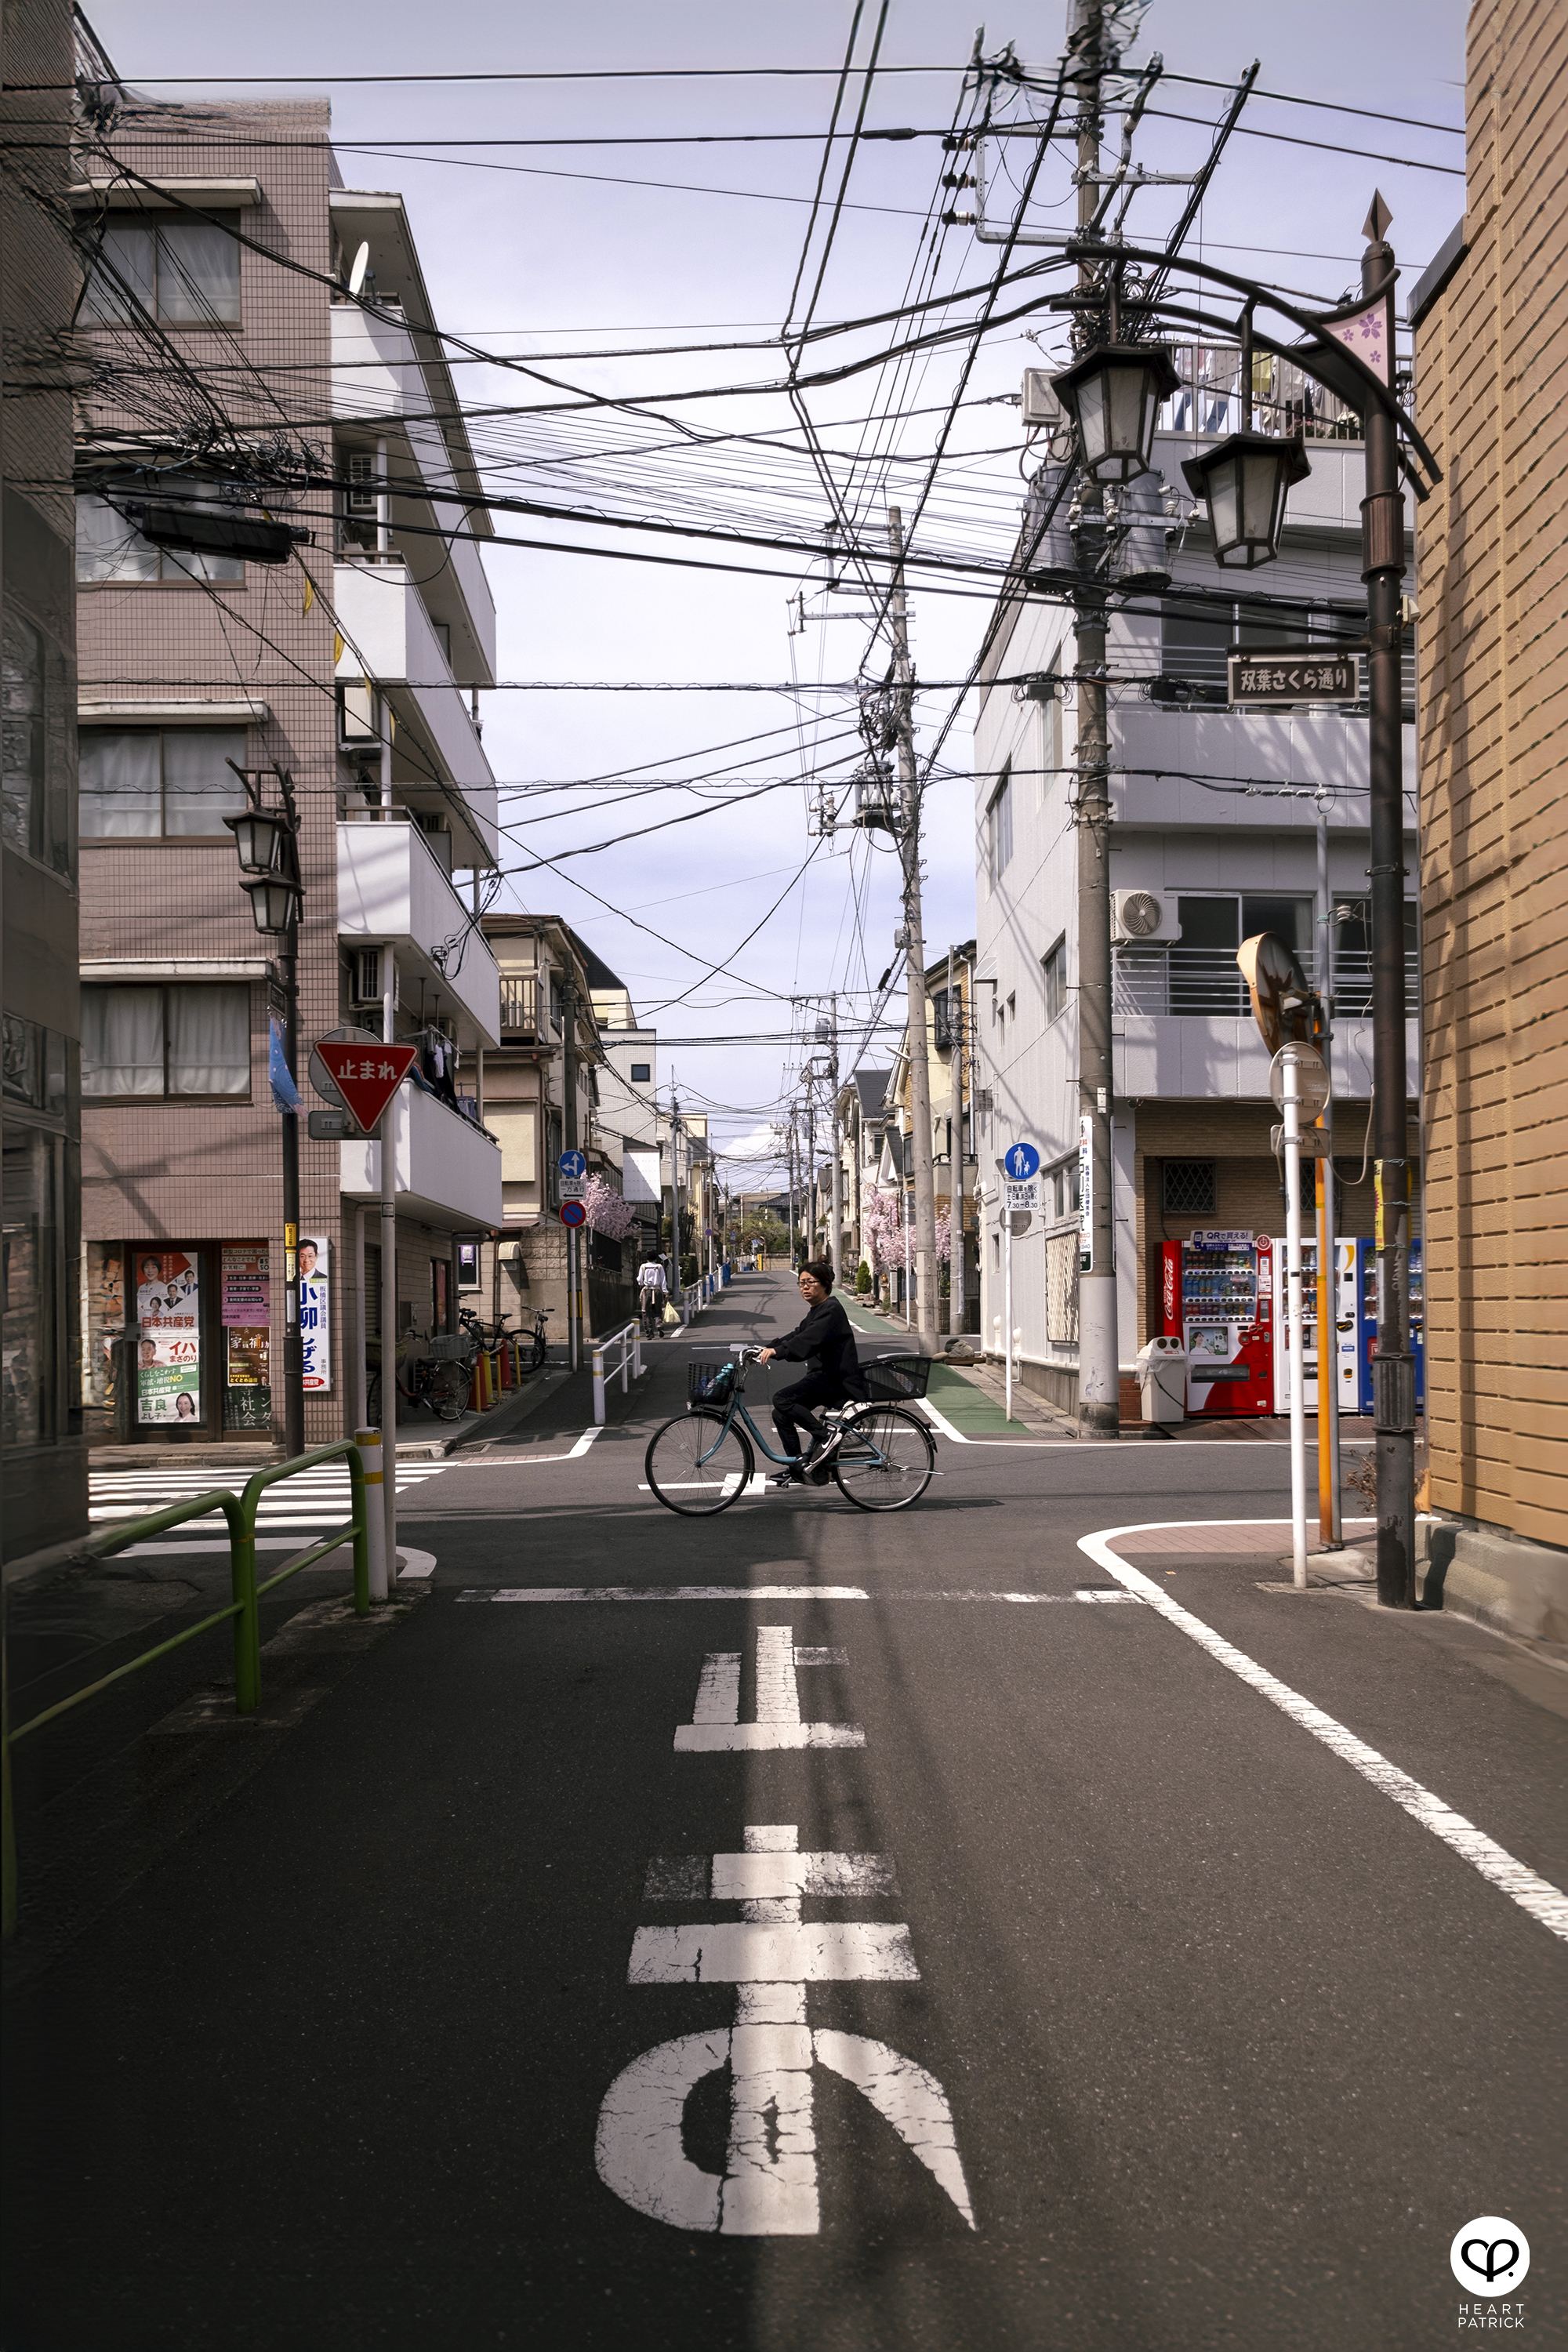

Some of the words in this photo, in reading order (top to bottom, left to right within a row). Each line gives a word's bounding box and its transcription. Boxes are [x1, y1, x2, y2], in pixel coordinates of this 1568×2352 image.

[1240, 668, 1347, 692] 双葉さくら通り
[337, 1059, 397, 1080] 止まれ
[142, 1316, 194, 1327] 日本共産党
[169, 1341, 197, 1355] イハ
[140, 1367, 176, 1378] くらしをこわす
[141, 1386, 172, 1396] 日本共産党
[140, 1399, 168, 1412] 吉良
